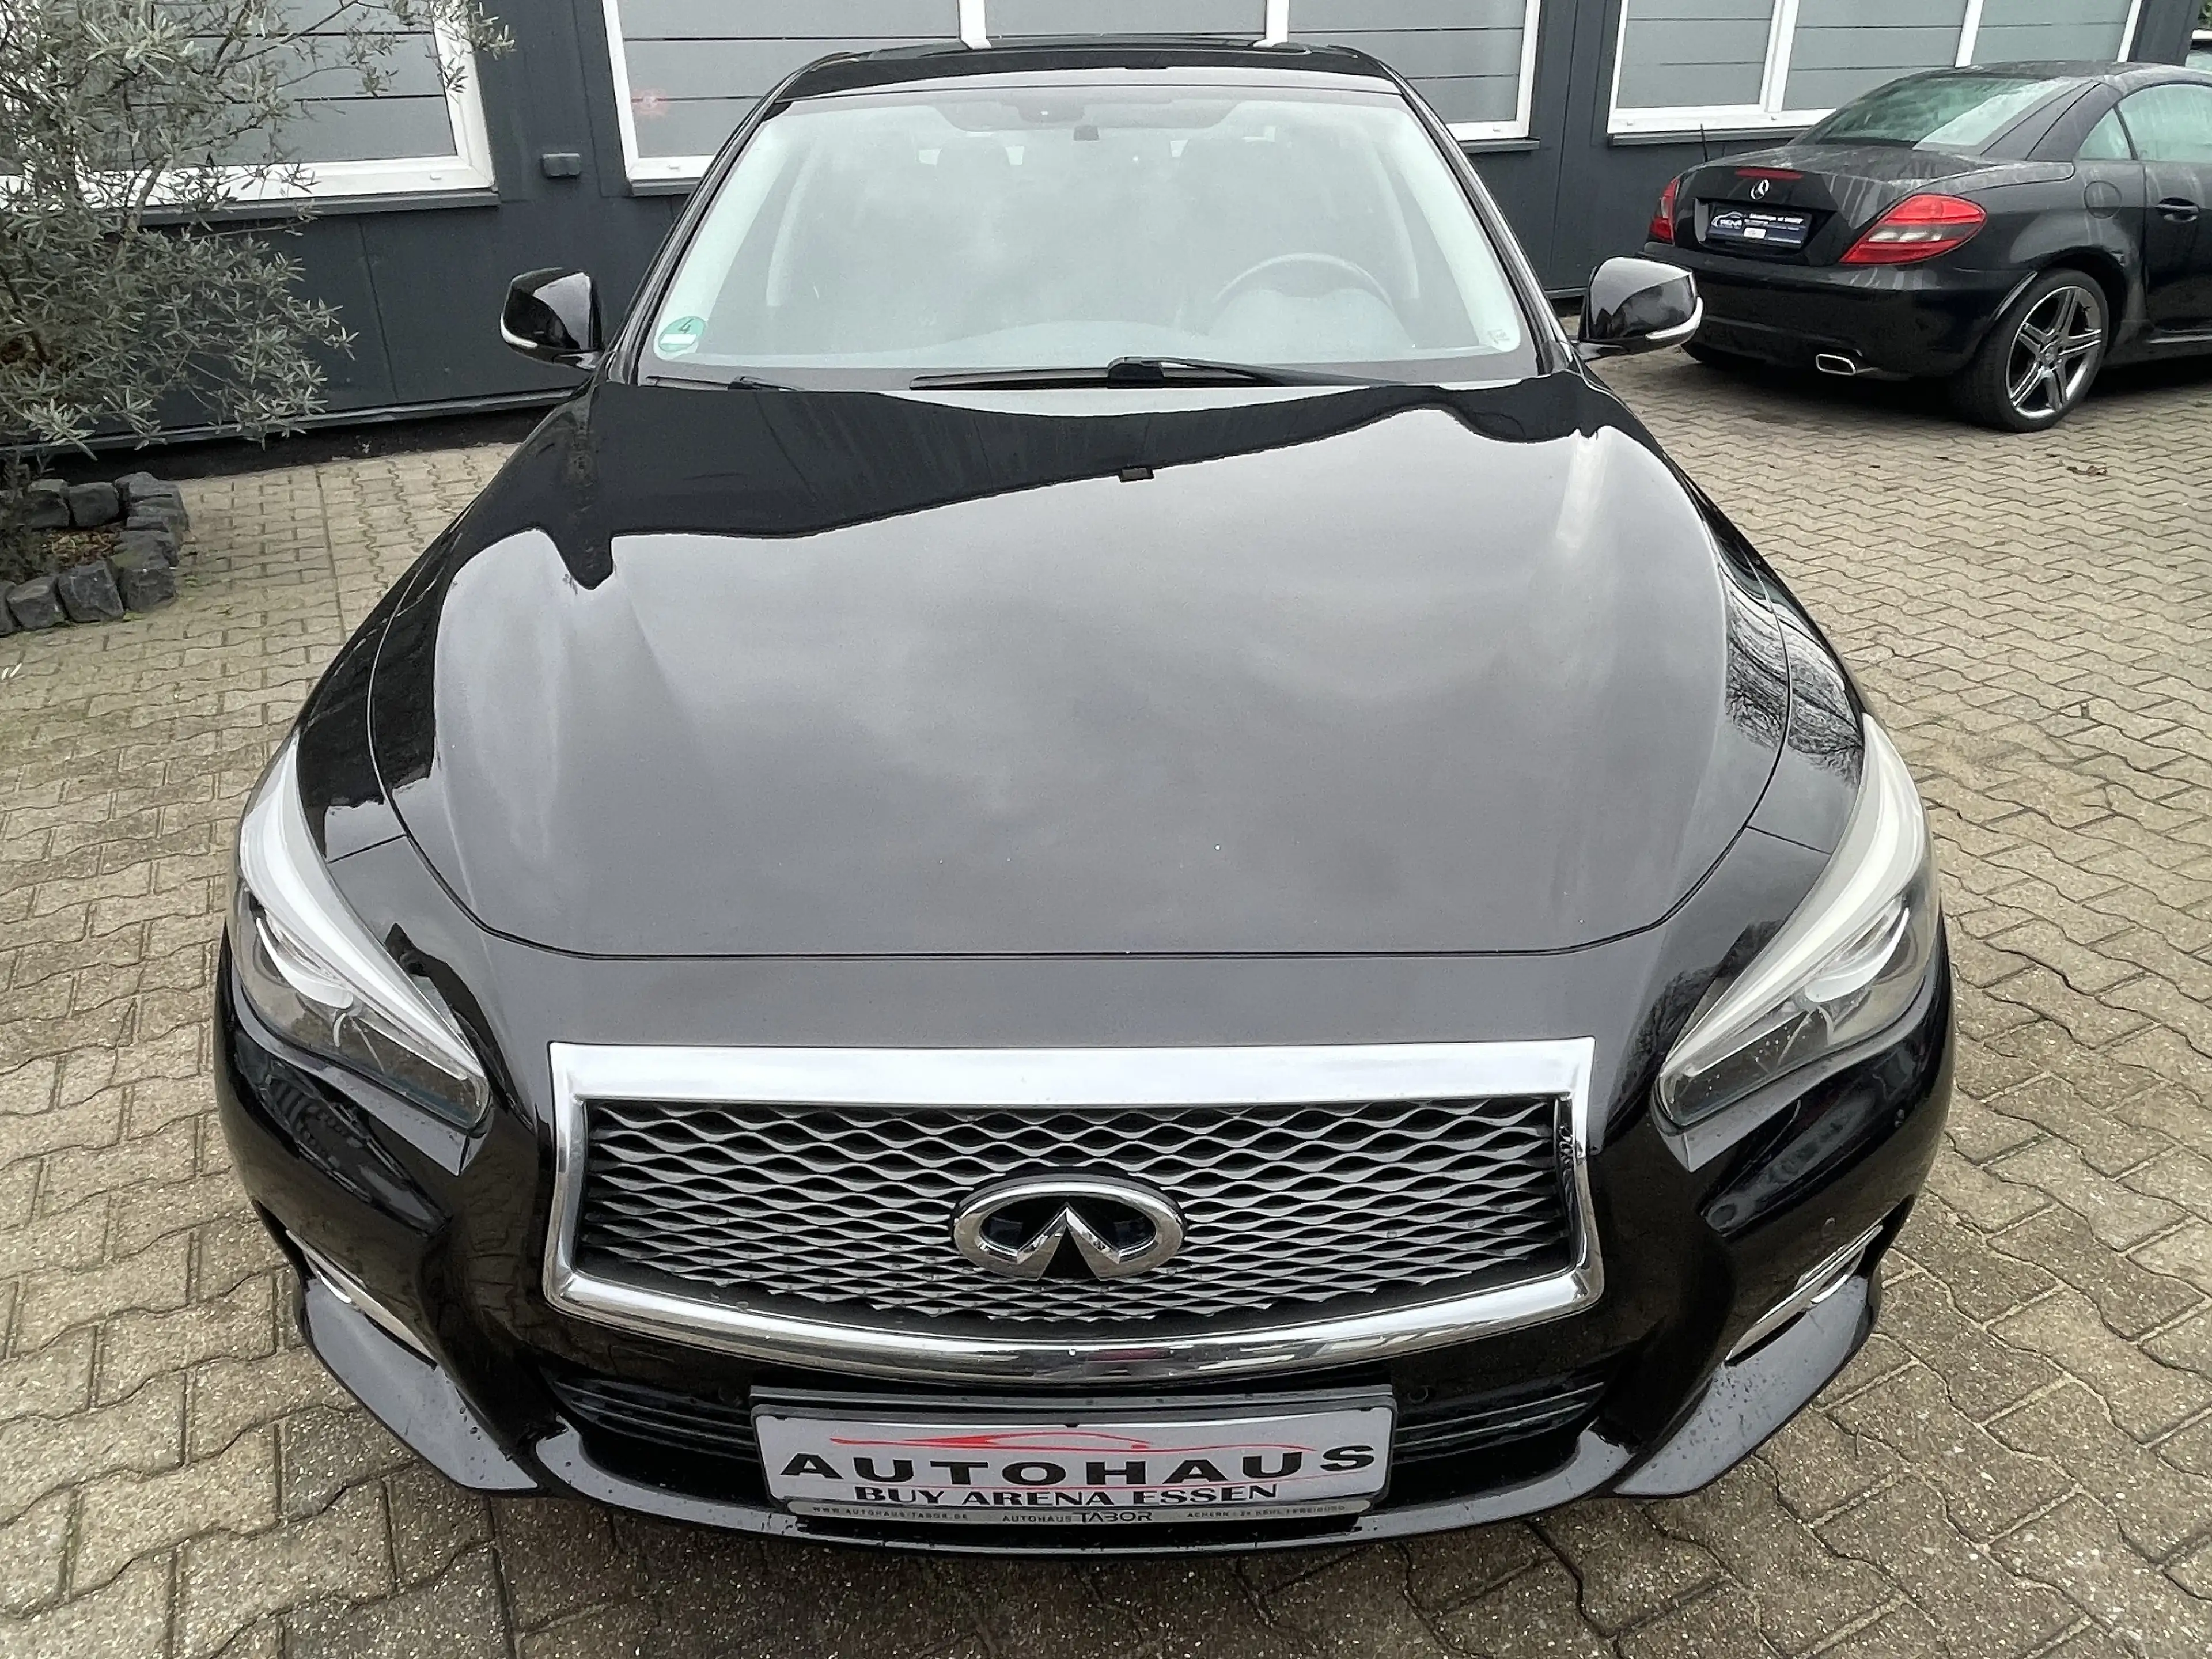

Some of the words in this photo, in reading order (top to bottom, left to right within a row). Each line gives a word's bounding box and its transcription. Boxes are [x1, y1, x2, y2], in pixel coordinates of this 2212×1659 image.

[678, 318, 694, 334] 4
[779, 1445, 1374, 1485] AUTOHAUS
[855, 1486, 945, 1504] BUY
[961, 1491, 1115, 1505] ARENA
[1132, 1483, 1277, 1505] ESSEN
[1002, 1515, 1072, 1523] AUTOHAUS
[1073, 1511, 1153, 1523] TABOR
